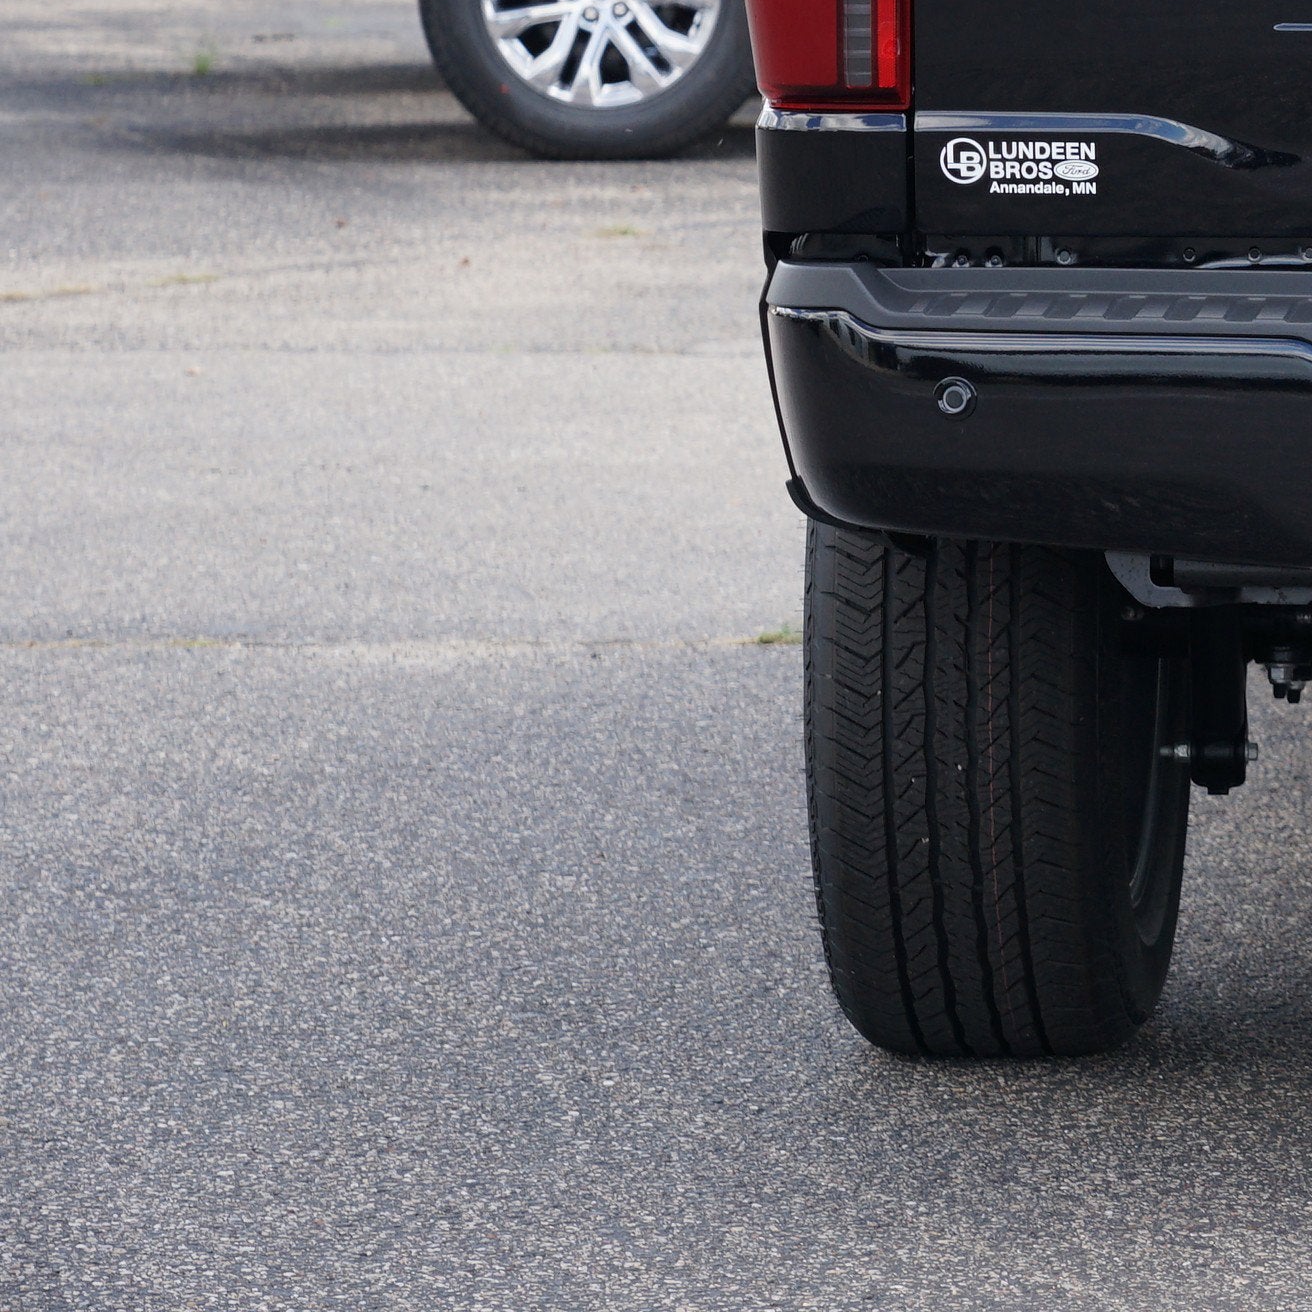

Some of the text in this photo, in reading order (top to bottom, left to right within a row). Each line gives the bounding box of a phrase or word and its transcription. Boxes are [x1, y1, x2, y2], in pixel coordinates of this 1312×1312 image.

[988, 141, 1096, 160] LUNDEEN
[989, 161, 1053, 179] BROS
[990, 181, 1097, 196] Annandale, MN
